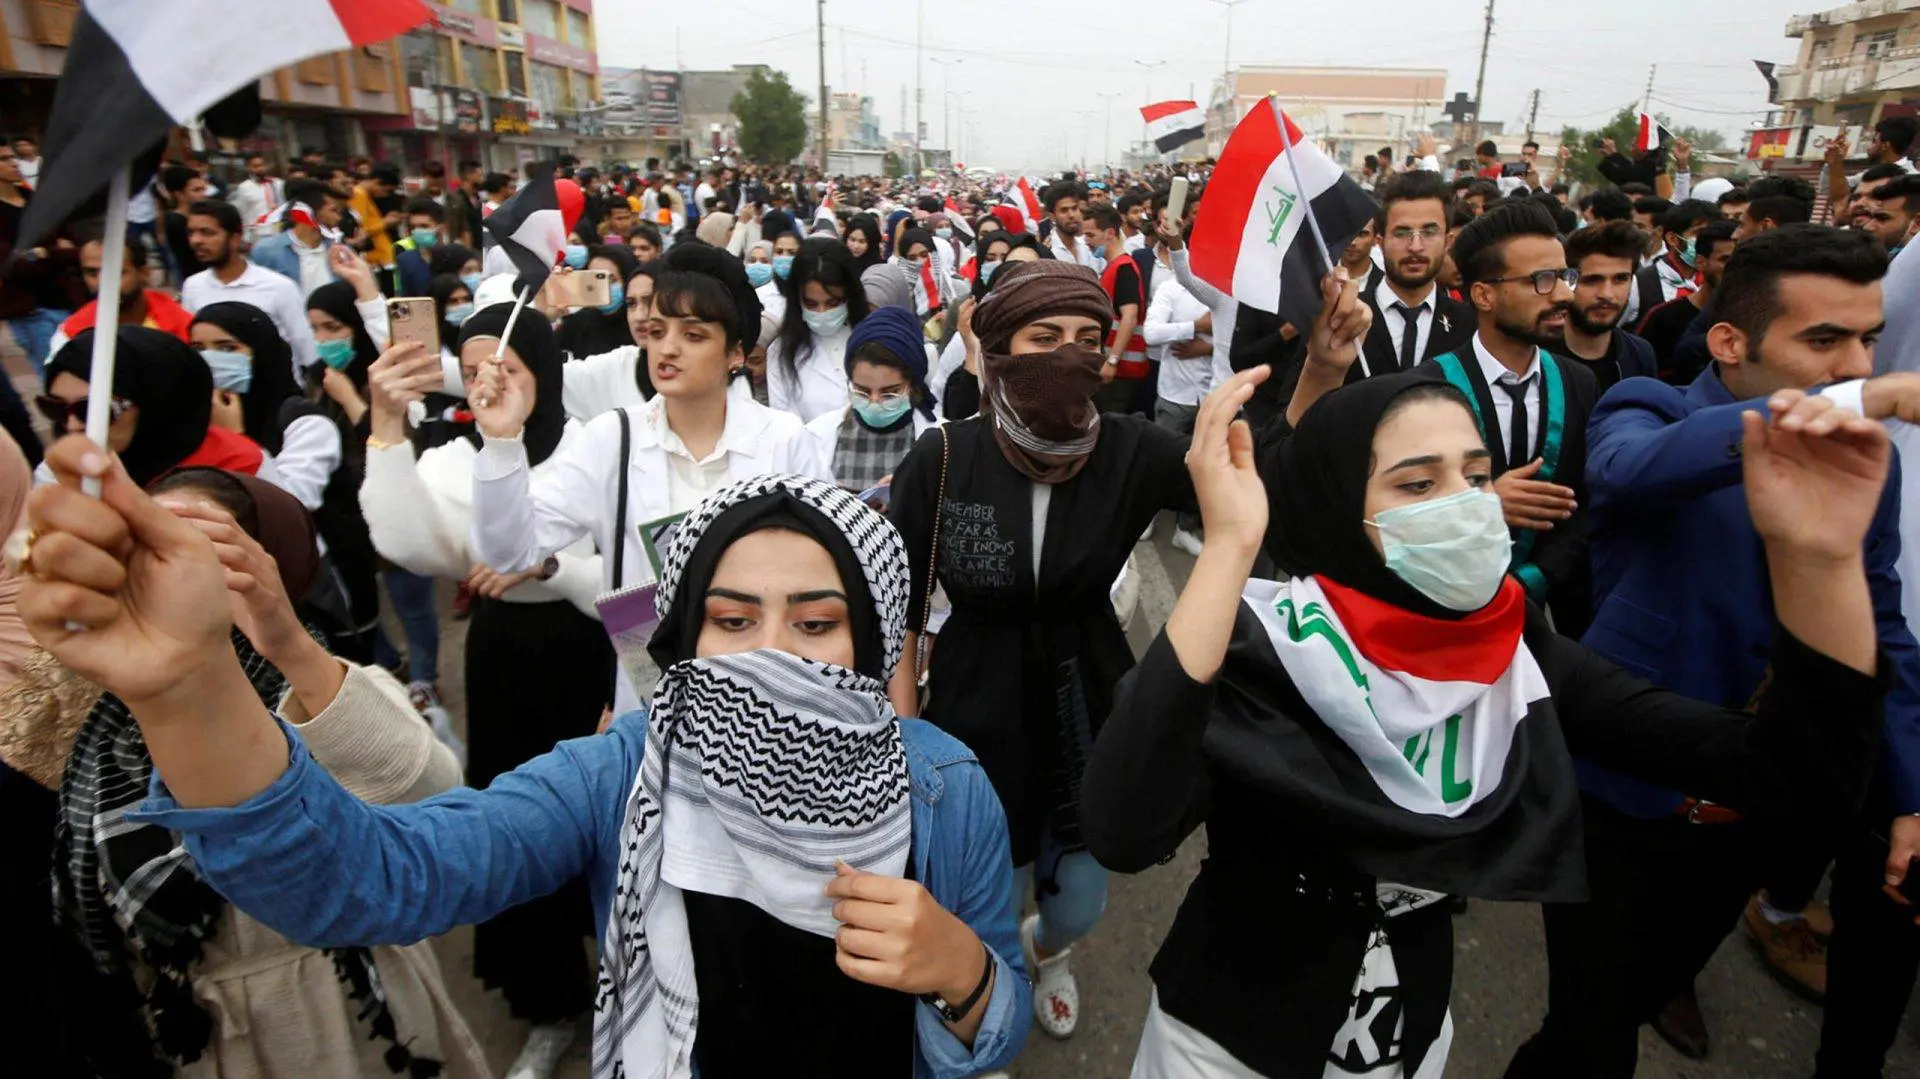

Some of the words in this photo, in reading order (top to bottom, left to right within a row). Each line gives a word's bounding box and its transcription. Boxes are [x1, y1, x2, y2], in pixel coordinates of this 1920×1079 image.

[954, 522, 980, 537] FAR
[983, 523, 998, 539] AS
[973, 540, 1016, 556] KNOWS
